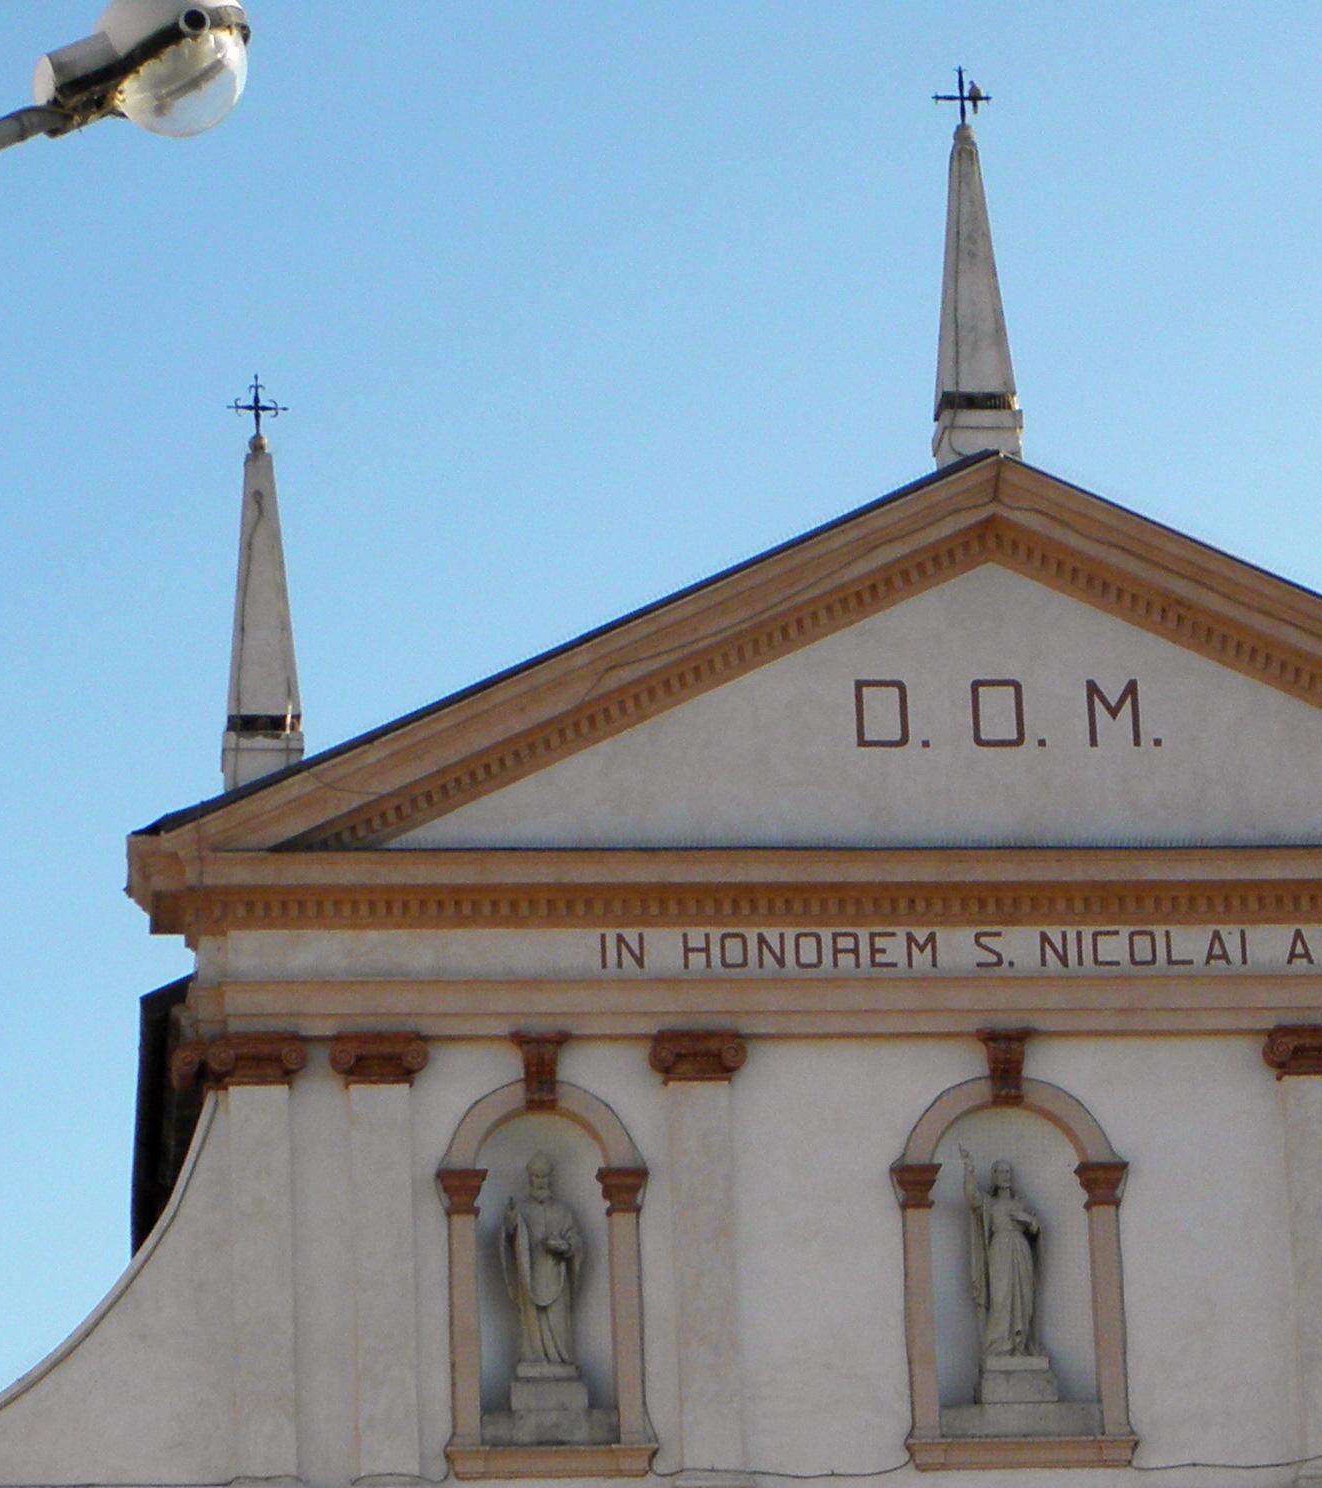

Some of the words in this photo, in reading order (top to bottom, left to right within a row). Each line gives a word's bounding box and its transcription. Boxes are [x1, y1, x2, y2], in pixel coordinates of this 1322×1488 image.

[854, 678, 931, 748] D.
[970, 678, 1047, 748] O.
[1085, 678, 1163, 748] M.
[599, 931, 646, 970] IN
[681, 930, 939, 970] HONOREM
[973, 930, 1016, 969] S.
[1038, 928, 1248, 969] NICOLAI
[1286, 927, 1315, 966] A
